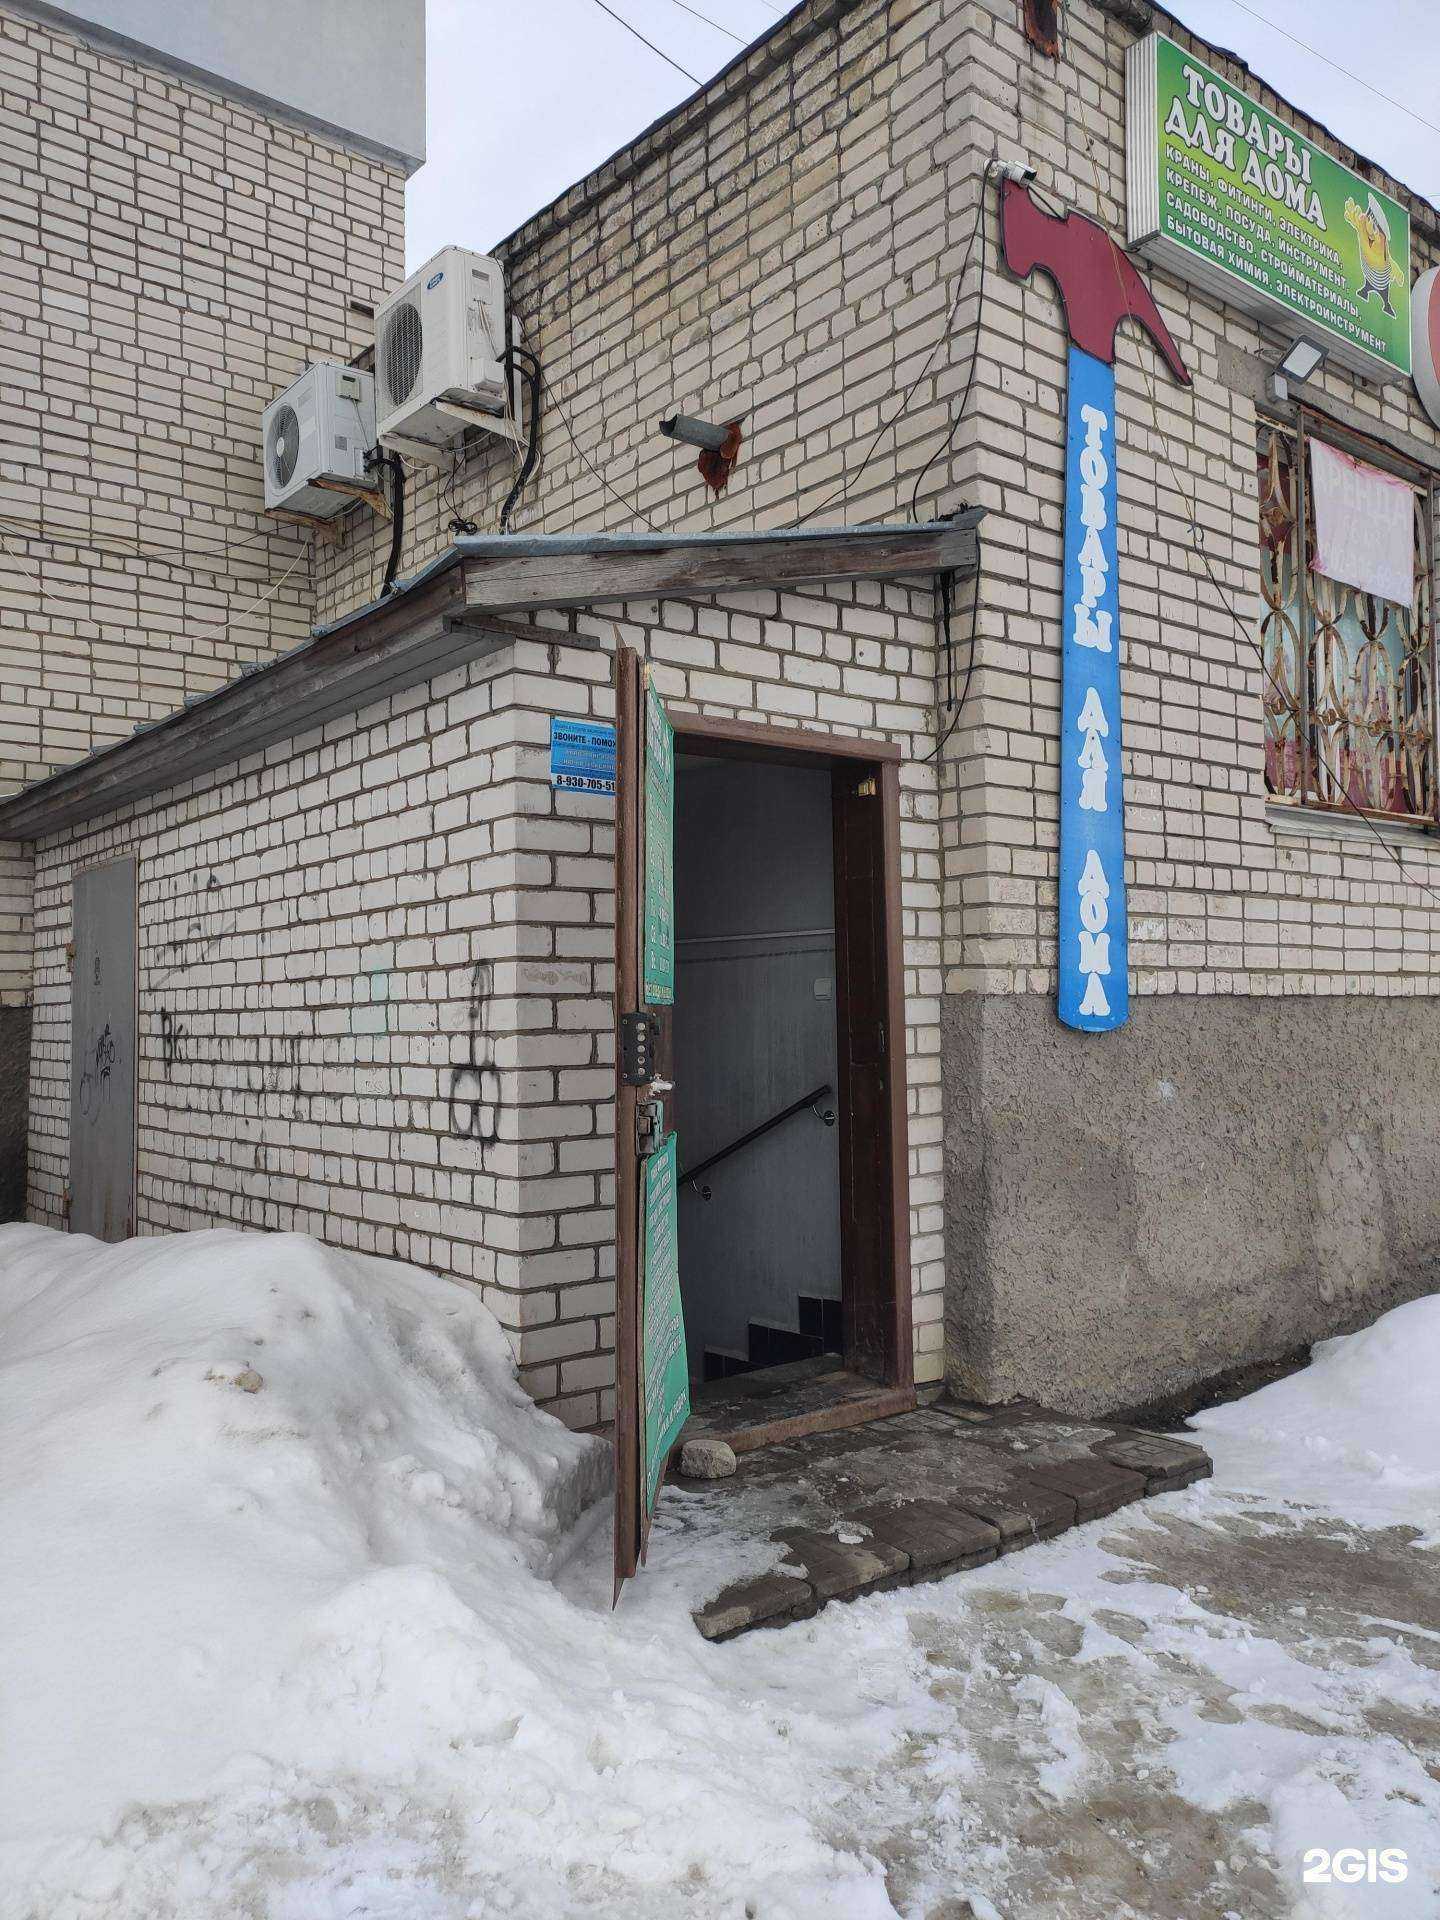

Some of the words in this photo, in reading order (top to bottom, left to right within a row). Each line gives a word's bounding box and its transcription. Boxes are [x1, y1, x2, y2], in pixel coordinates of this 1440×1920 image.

[1165, 96, 1236, 171] ДЛЯ
[1242, 148, 1327, 231] ДОМА
[1183, 65, 1312, 184] ТОВАРЫ
[1166, 143, 1214, 188] КРАНЫ,
[1218, 178, 1276, 226] ФИТИНГИ,
[1280, 217, 1343, 269] ЭЛЕКТРИКА,
[1166, 167, 1222, 215] КРЕПЕЖ,
[1226, 205, 1275, 247] ПОСУДА,
[1166, 191, 1257, 258] САДОВОДСТВО,
[1261, 249, 1361, 321] СТРОЙМАТЕРИАЛЫ,
[1167, 214, 1224, 259] БЫТОВАЯ
[1277, 280, 1387, 352] ЭЛЕКТРОИНСТРУМЕНТ
[1073, 403, 1113, 653] ТОВАРЫ
[553, 732, 587, 744] ЗВОНИТЕ
[1078, 687, 1109, 812] ДЛЯ
[1078, 850, 1111, 1016] ДОМА
